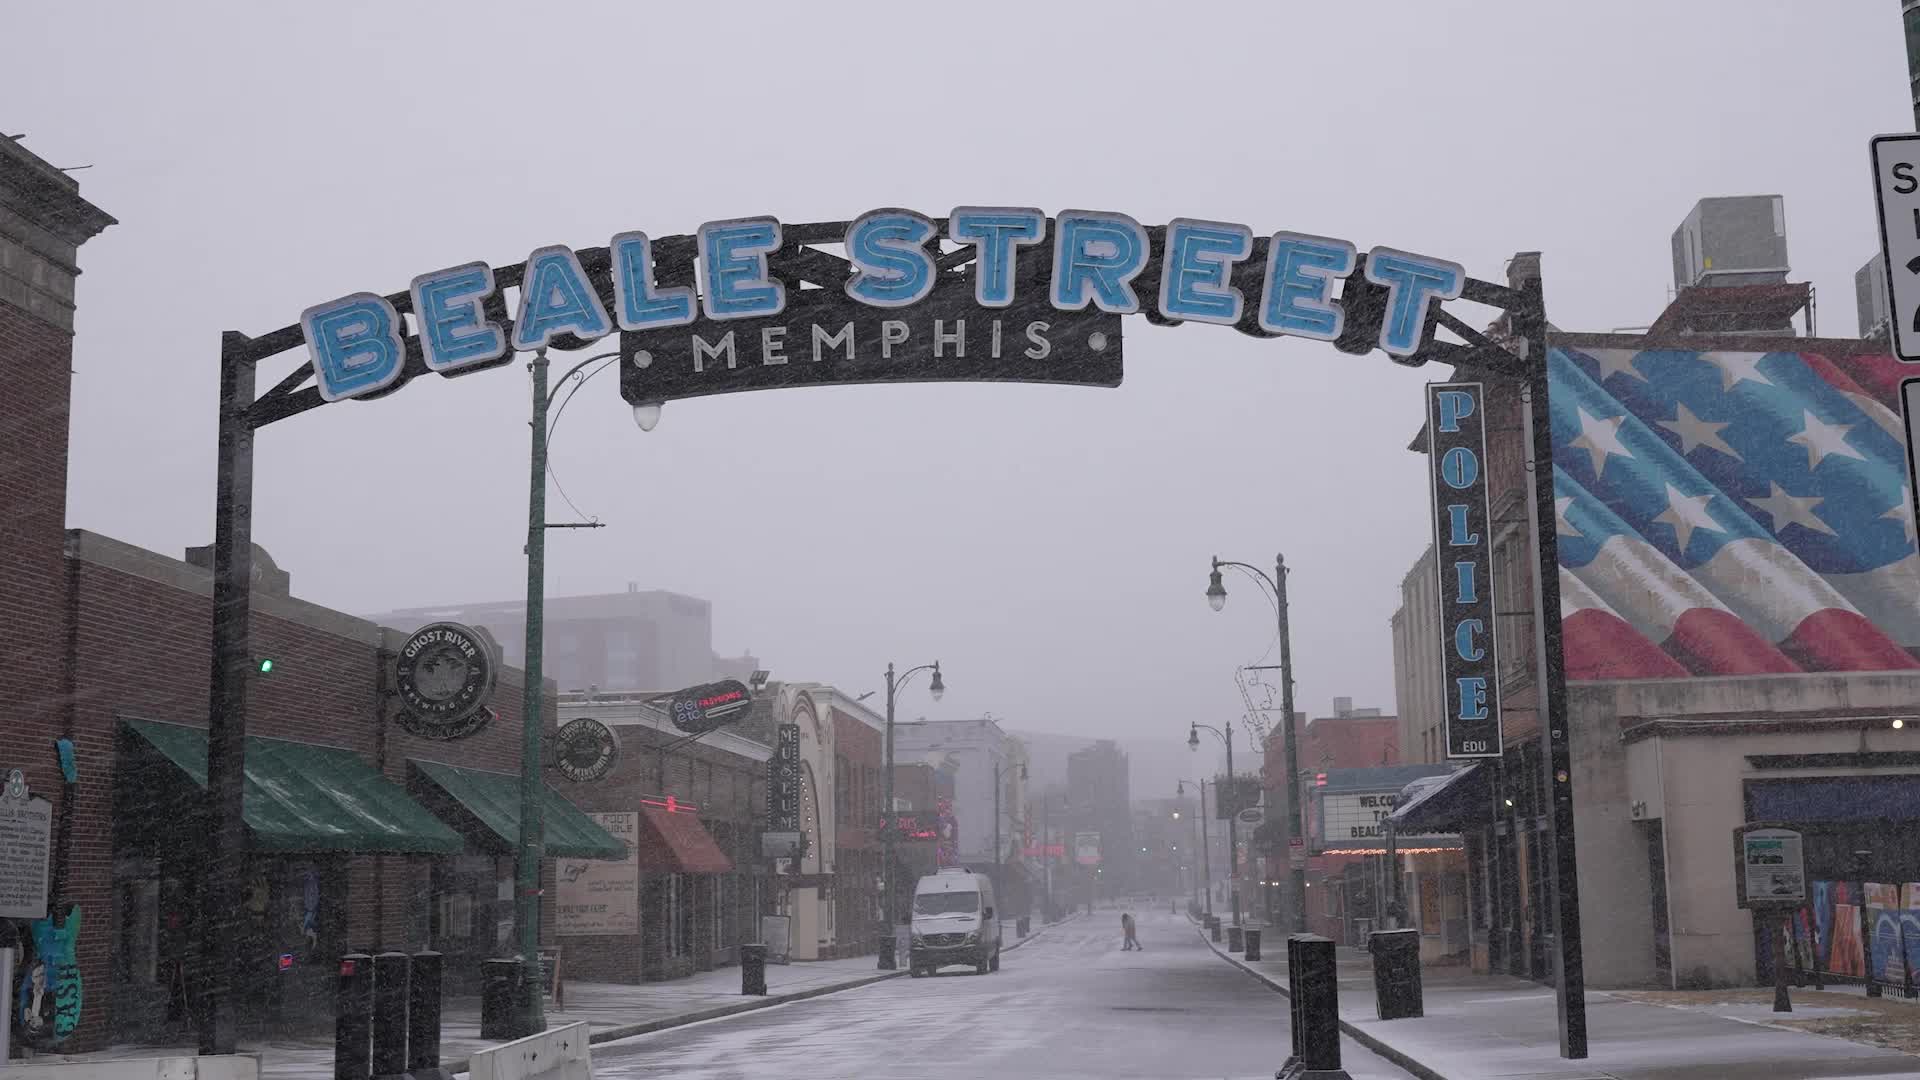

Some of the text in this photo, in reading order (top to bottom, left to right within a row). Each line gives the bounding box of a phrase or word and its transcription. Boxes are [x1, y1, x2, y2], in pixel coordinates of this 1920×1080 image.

[300, 206, 1466, 402] BEALE STREET
[692, 319, 1053, 372] MEMPHIS
[1437, 390, 1489, 721] POLICE
[405, 630, 476, 659] GHOST RIVER
[1463, 741, 1487, 752] EDU
[780, 729, 793, 829] MUSEUM
[1359, 795, 1393, 808] WELCO
[55, 963, 79, 1039] CASH
